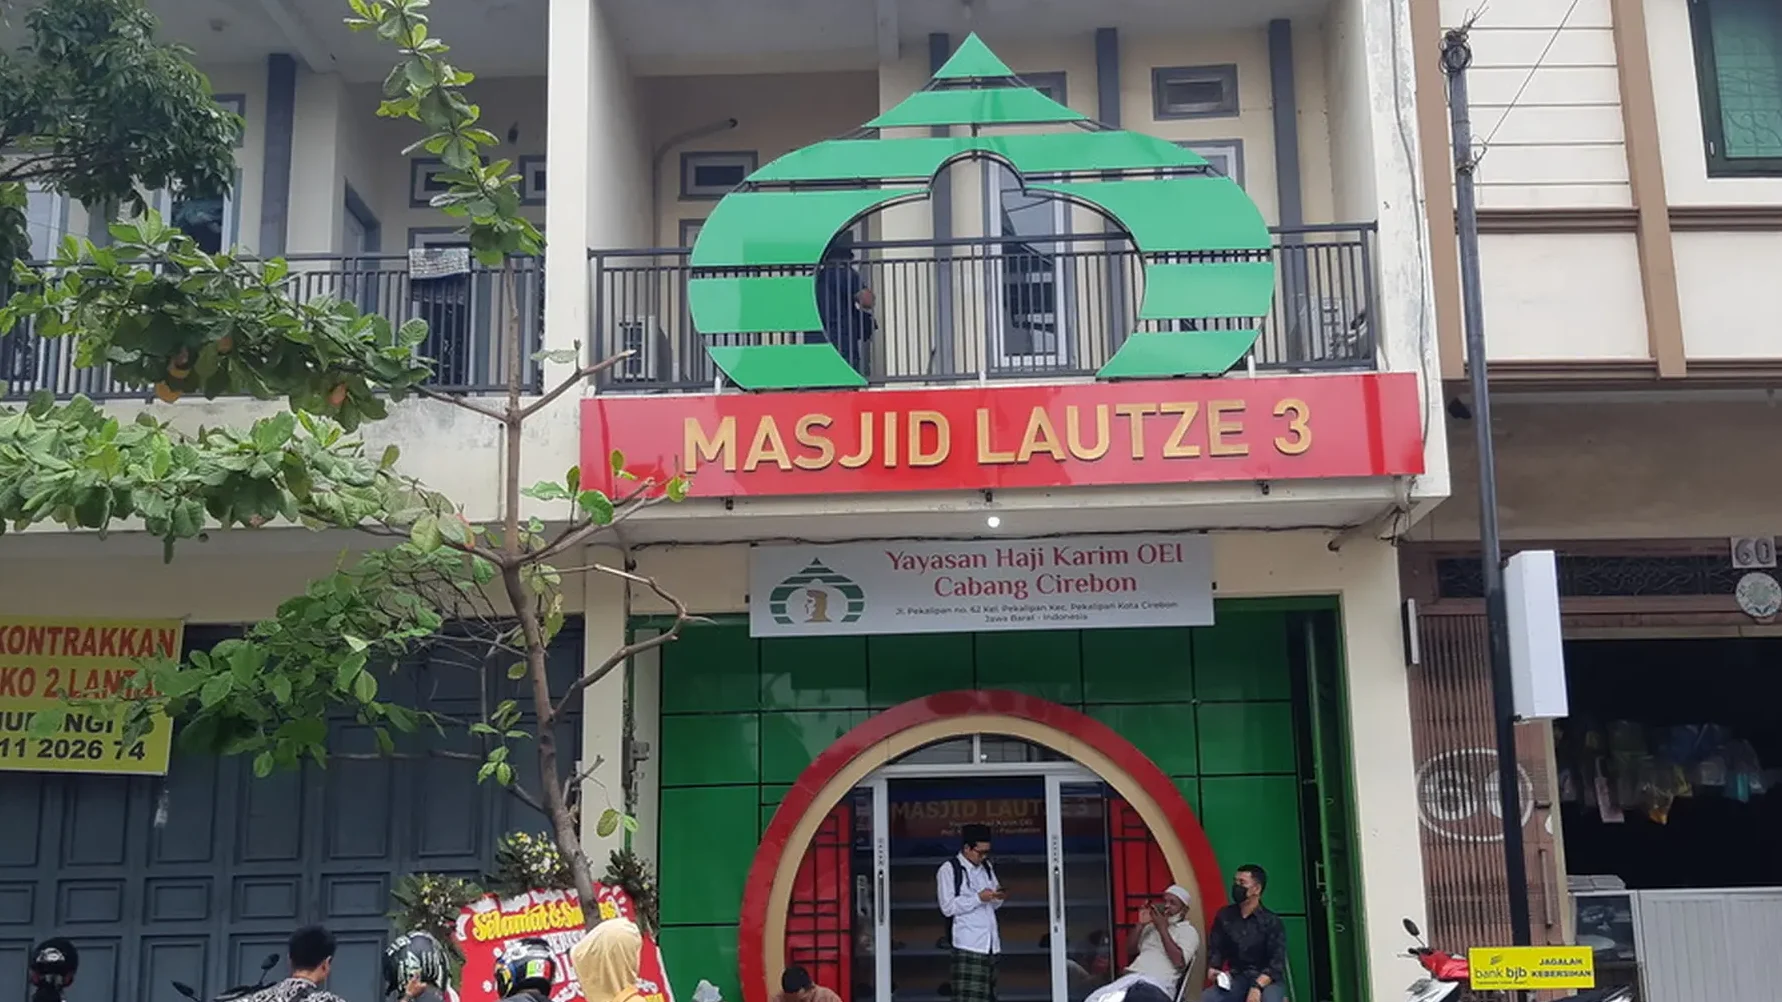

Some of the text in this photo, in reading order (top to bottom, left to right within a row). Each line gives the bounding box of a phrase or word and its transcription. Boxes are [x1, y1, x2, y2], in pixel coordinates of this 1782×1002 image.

[684, 398, 1312, 473] MASJID LAUTZE 3
[885, 543, 1184, 574] Yayasan Haji Karim OEI
[1735, 538, 1773, 565] 60
[934, 573, 1137, 600] Cabang Cirebon
[907, 606, 951, 616] Pekalipan
[1001, 603, 1047, 613] Pekalipan
[1071, 602, 1115, 611] Pekalipan
[1141, 601, 1178, 609] Cirebon
[985, 615, 1008, 623] Jawa
[1010, 614, 1035, 622] Barat
[1043, 613, 1088, 621] Indonesia
[43, 667, 60, 698] 2
[36, 738, 103, 760] 2026
[113, 740, 145, 761] 74
[892, 800, 977, 819] MASJID
[472, 904, 549, 941] Selamat
[1476, 966, 1527, 981] bank bjb
[1539, 958, 1583, 966] JAGALAH
[1531, 970, 1592, 978] KEBERSIHAN
